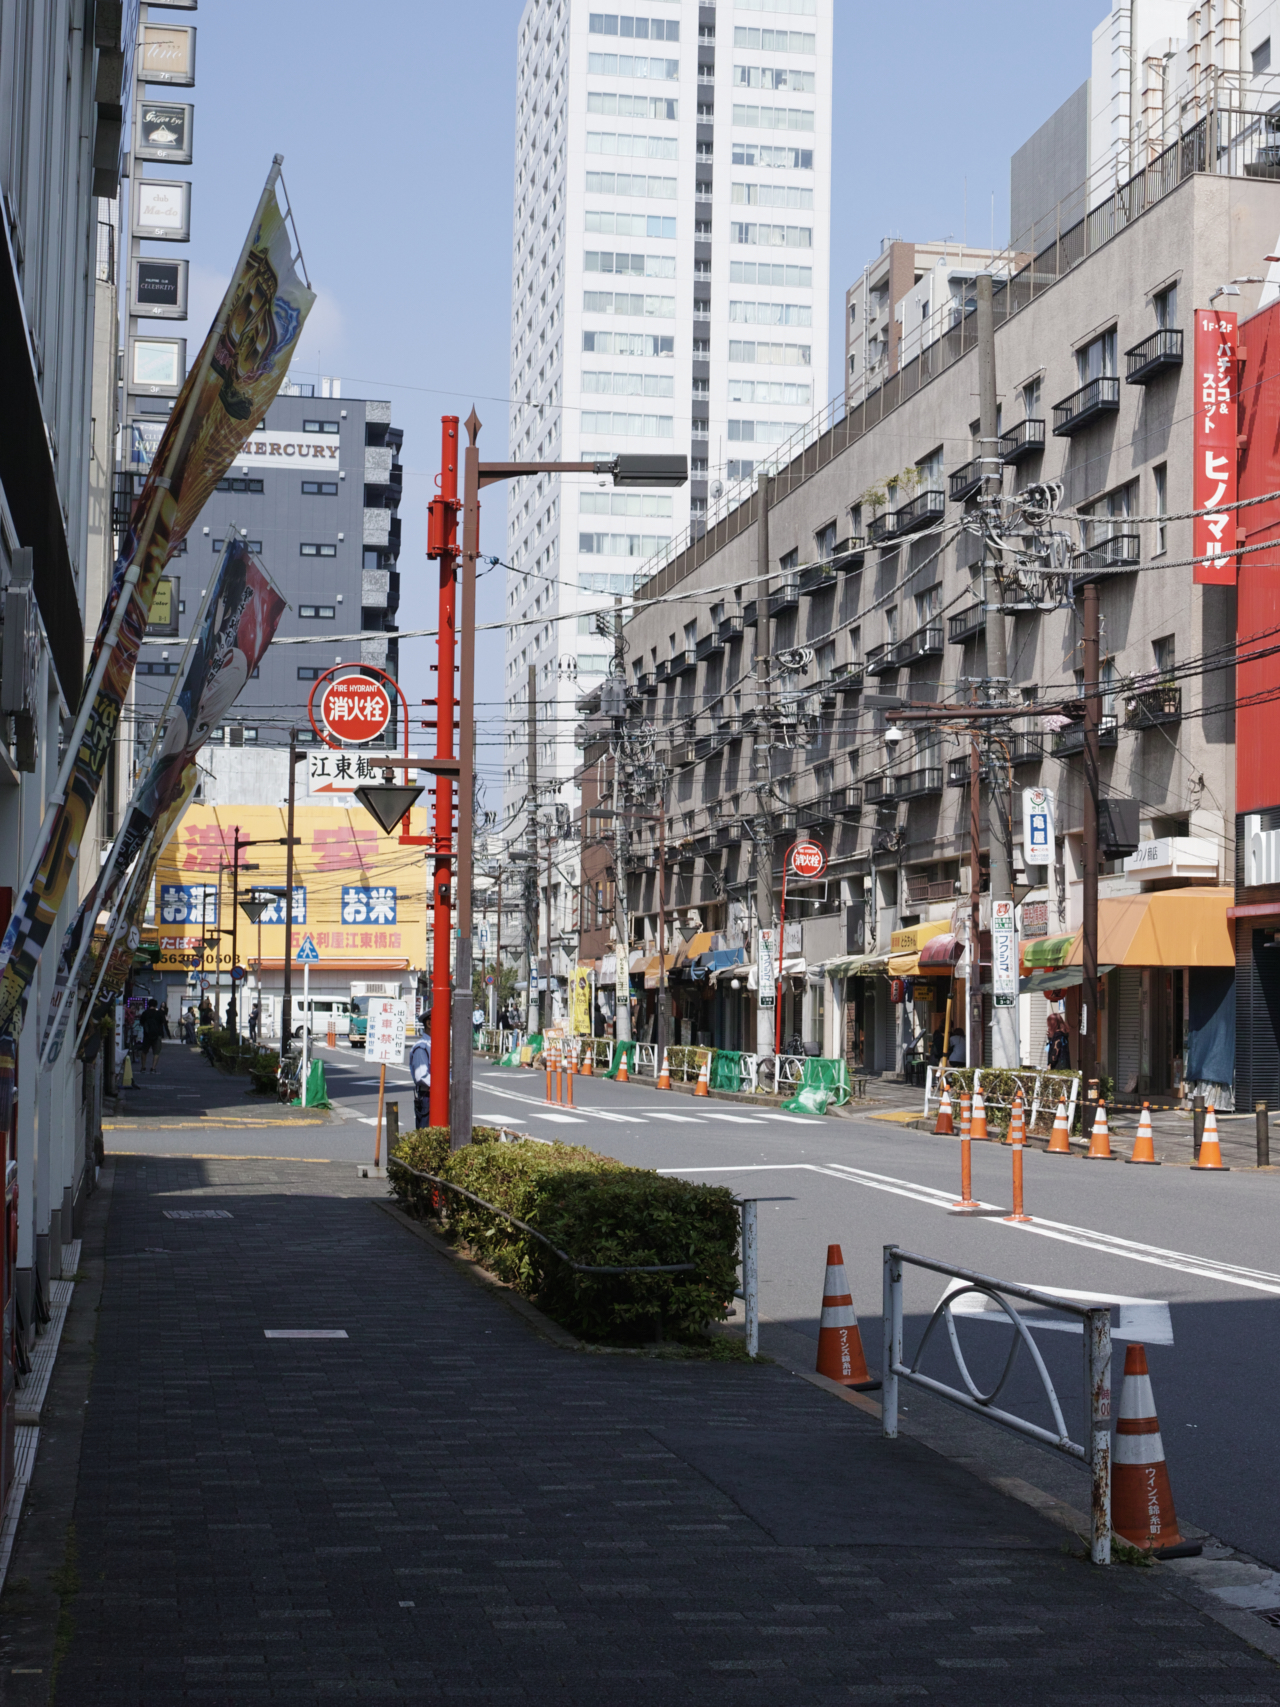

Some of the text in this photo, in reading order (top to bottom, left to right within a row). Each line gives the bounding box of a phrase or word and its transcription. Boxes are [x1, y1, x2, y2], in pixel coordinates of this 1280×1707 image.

[143, 111, 183, 126] Golden Eye
[157, 149, 168, 157] 6F
[143, 205, 178, 217] Ma-do
[153, 194, 169, 202] club
[155, 228, 165, 236] 5F
[150, 385, 160, 393] 3F
[1202, 373, 1216, 434] スロット
[239, 441, 341, 458] MERCURY
[1203, 451, 1230, 569] ヒノマル
[329, 696, 385, 721] 消火栓
[795, 854, 820, 867] 消火栓
[163, 887, 217, 923] お酒
[343, 888, 396, 924] お米
[999, 936, 1009, 972] フクシマ
[379, 1002, 394, 1060] 駐車禁止
[394, 1010, 405, 1057] 出入口に付き
[839, 1329, 852, 1376] ウインズ錦糸町
[1145, 1467, 1162, 1534] ウインズ錦糸町
